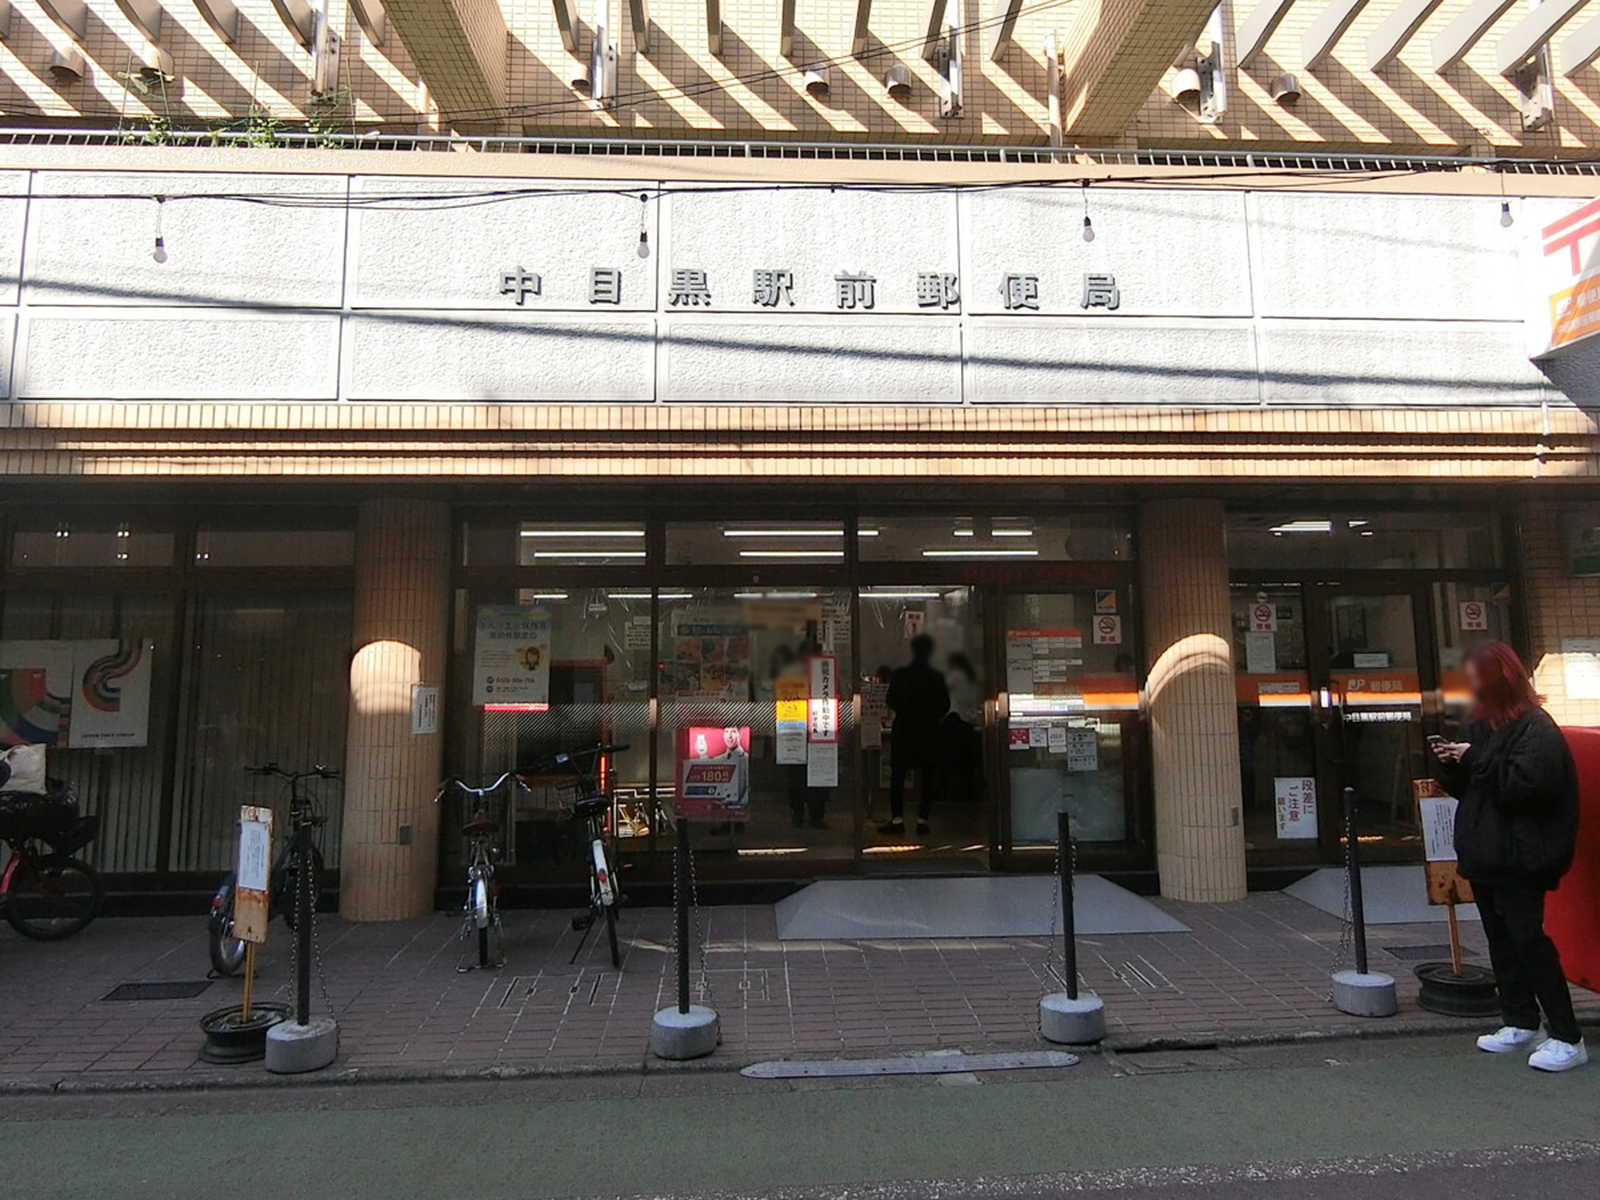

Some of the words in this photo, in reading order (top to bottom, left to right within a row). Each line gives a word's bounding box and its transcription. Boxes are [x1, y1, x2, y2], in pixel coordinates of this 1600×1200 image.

[499, 266, 1121, 311] 中目黒駅前郵便局
